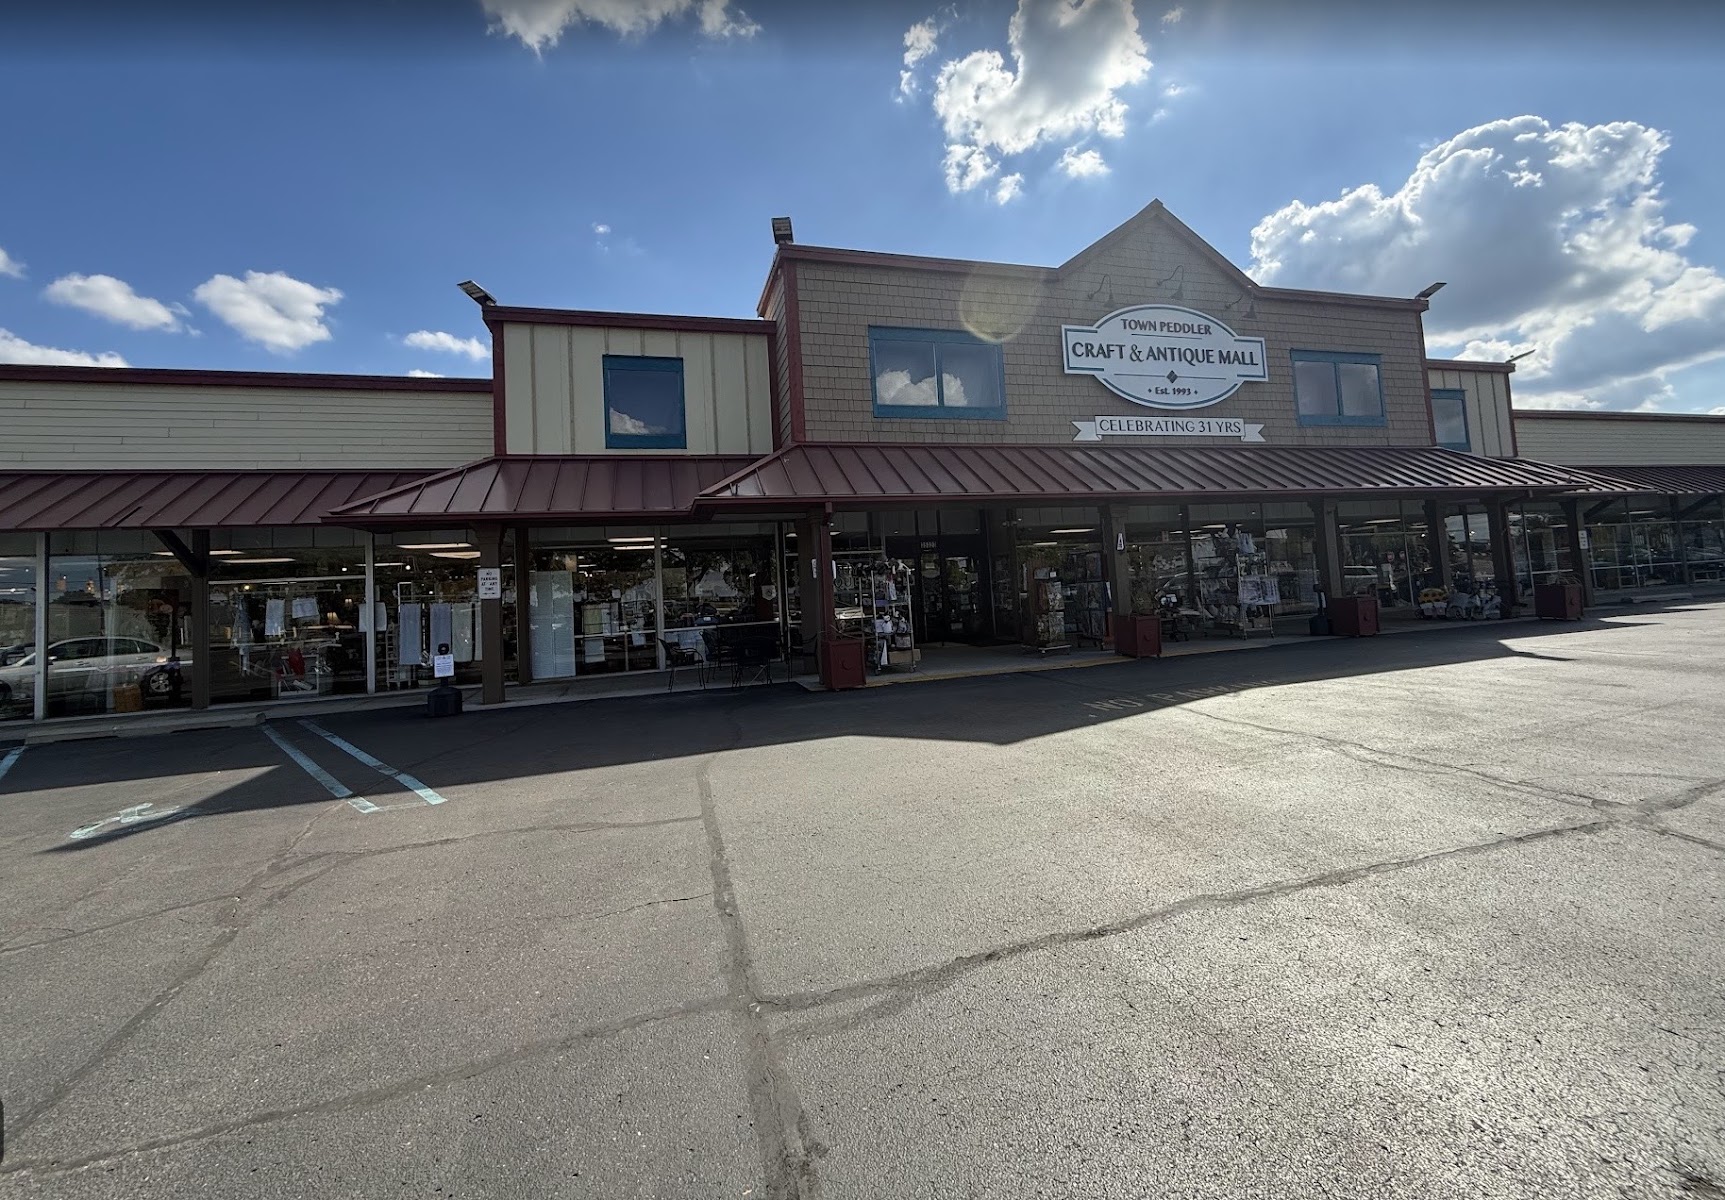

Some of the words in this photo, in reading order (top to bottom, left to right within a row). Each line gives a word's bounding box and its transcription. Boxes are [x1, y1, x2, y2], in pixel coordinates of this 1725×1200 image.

[1120, 318, 1158, 332] TOWN
[1160, 321, 1212, 336] PEDDLER
[1071, 341, 1126, 360] CRAFT
[1129, 343, 1145, 363] &
[1146, 345, 1216, 367] ANTIQUE
[1218, 350, 1260, 366] MALL
[1172, 387, 1192, 396] 1993
[1099, 419, 1196, 433] CELEBRATING
[1198, 420, 1212, 434] 31
[1216, 421, 1242, 434] YRS
